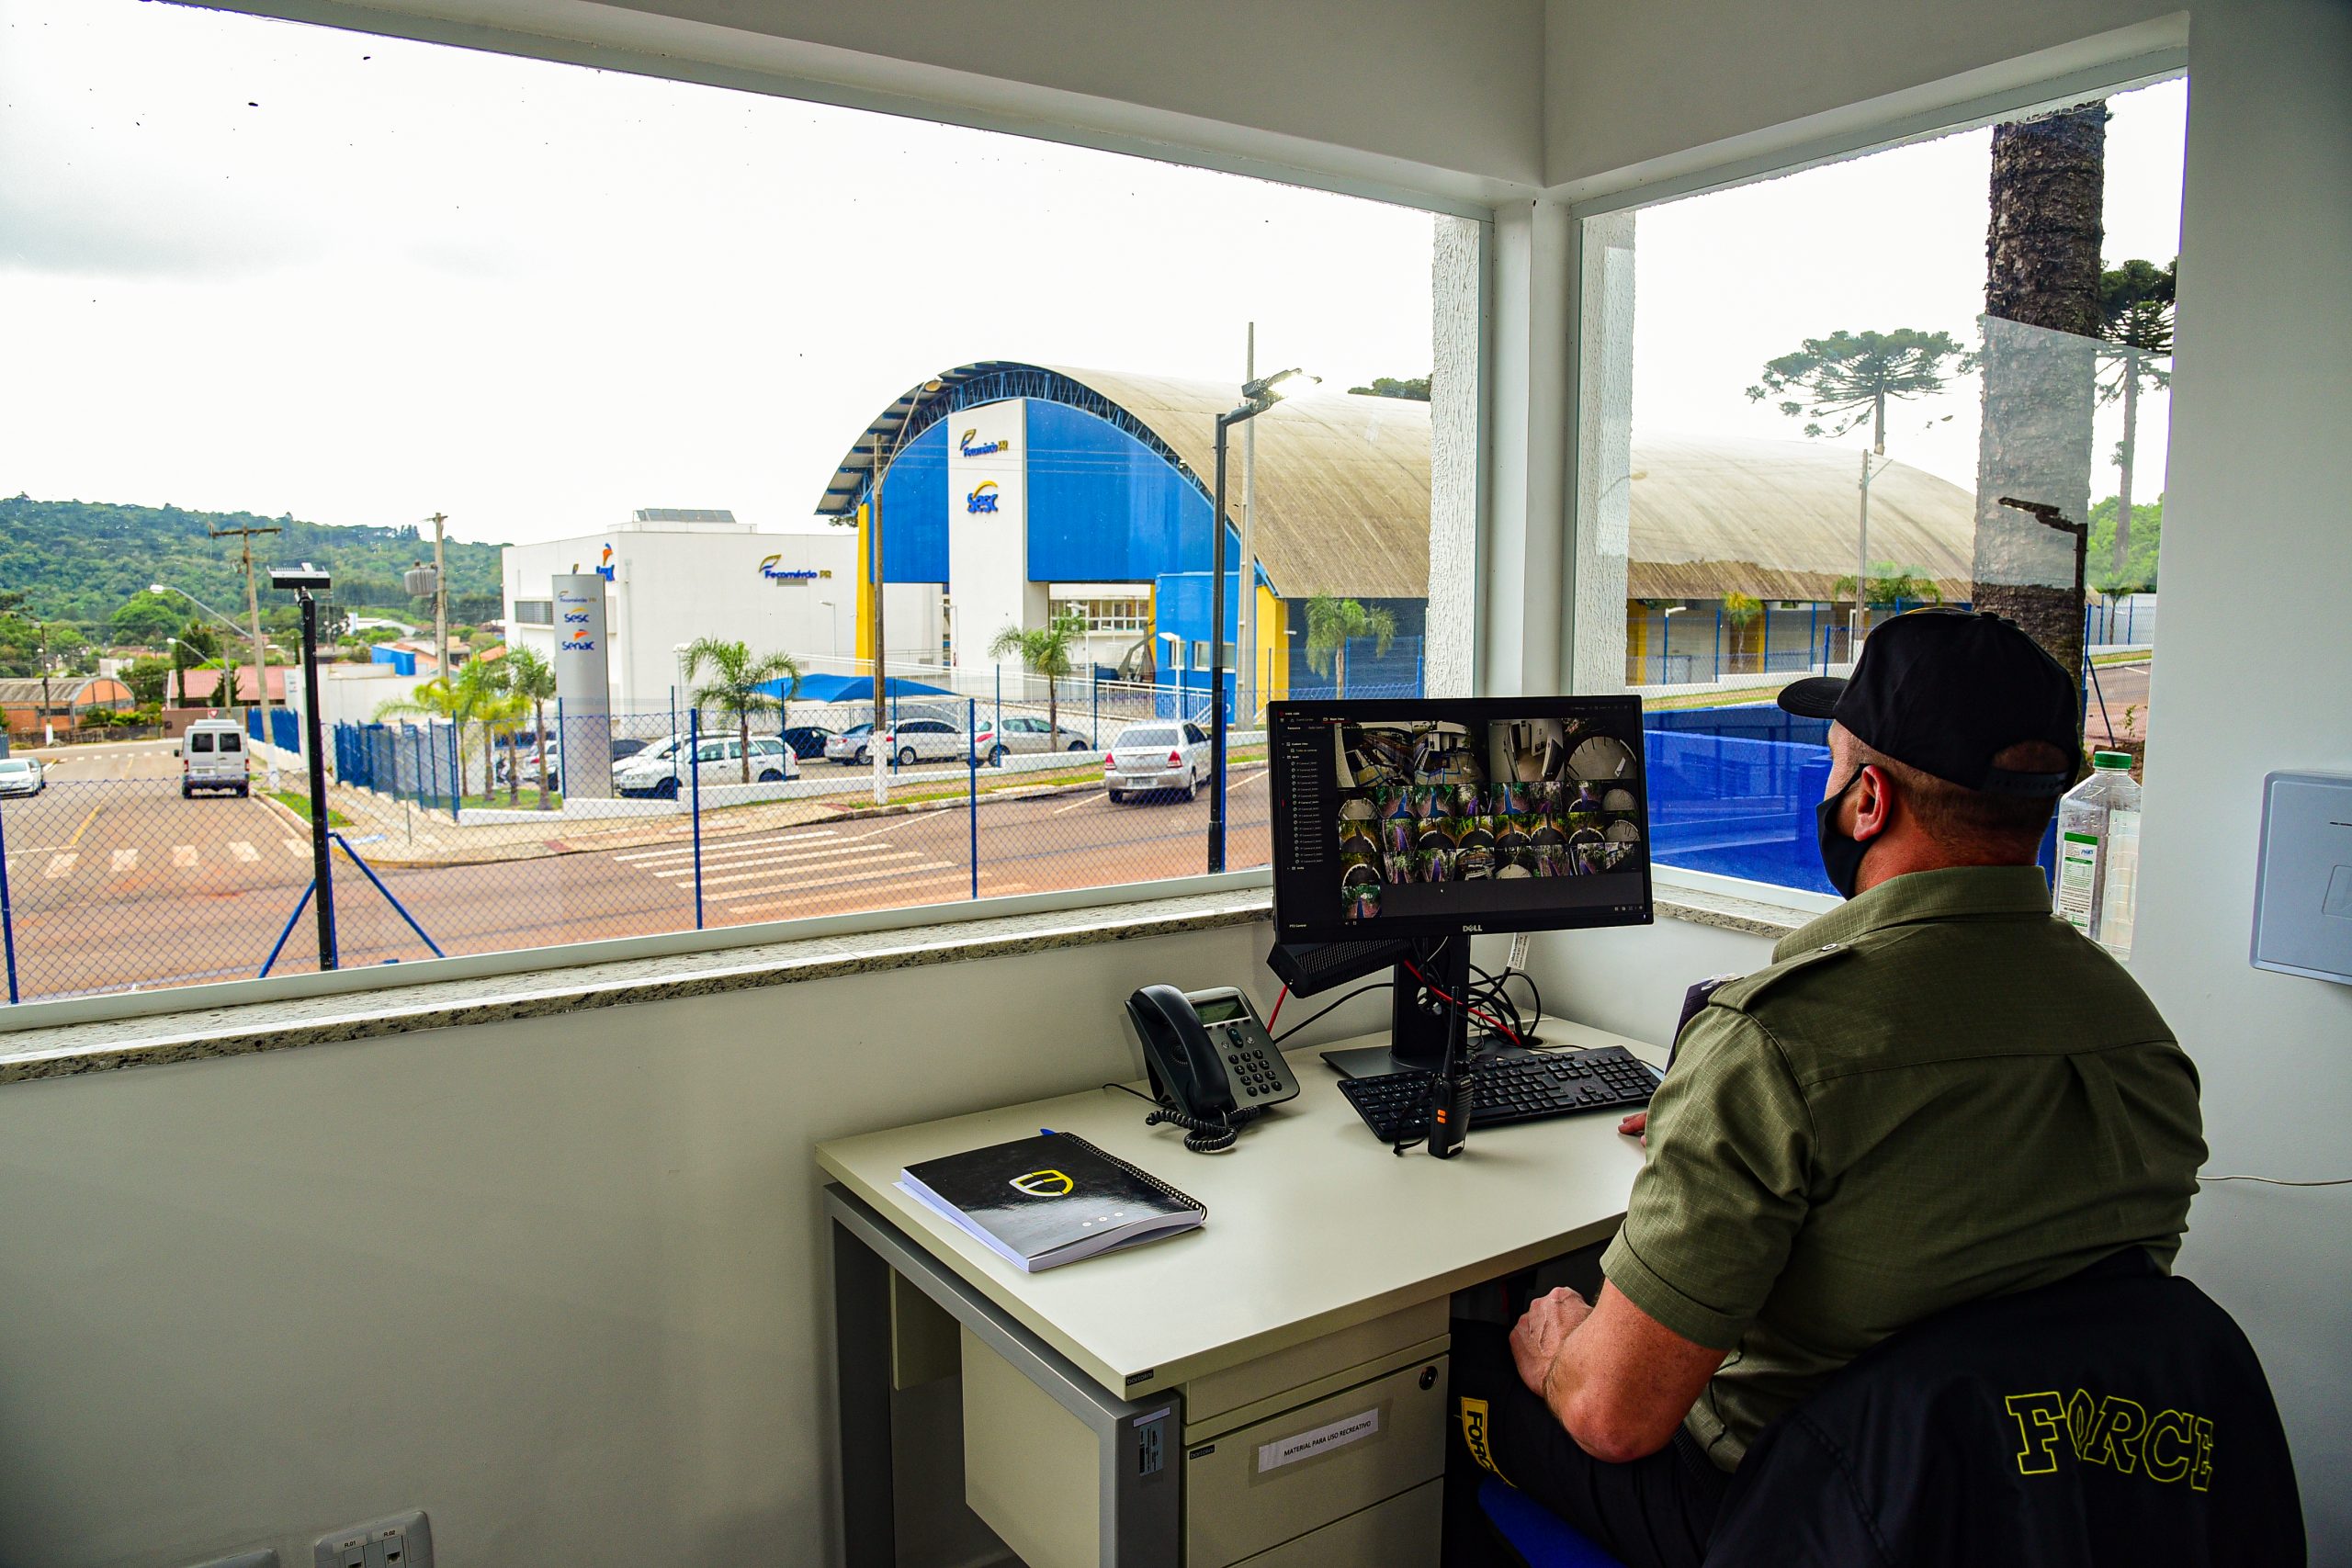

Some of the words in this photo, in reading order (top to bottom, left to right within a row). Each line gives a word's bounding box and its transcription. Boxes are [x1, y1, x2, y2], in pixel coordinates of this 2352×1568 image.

[562, 641, 595, 650] Senac
[1463, 924, 1483, 932] DELL
[1283, 1442, 1311, 1457] MATERIAL
[1312, 1437, 1326, 1446] PARA
[1327, 1432, 1339, 1441] USO
[1340, 1420, 1371, 1436] RECREATIVO
